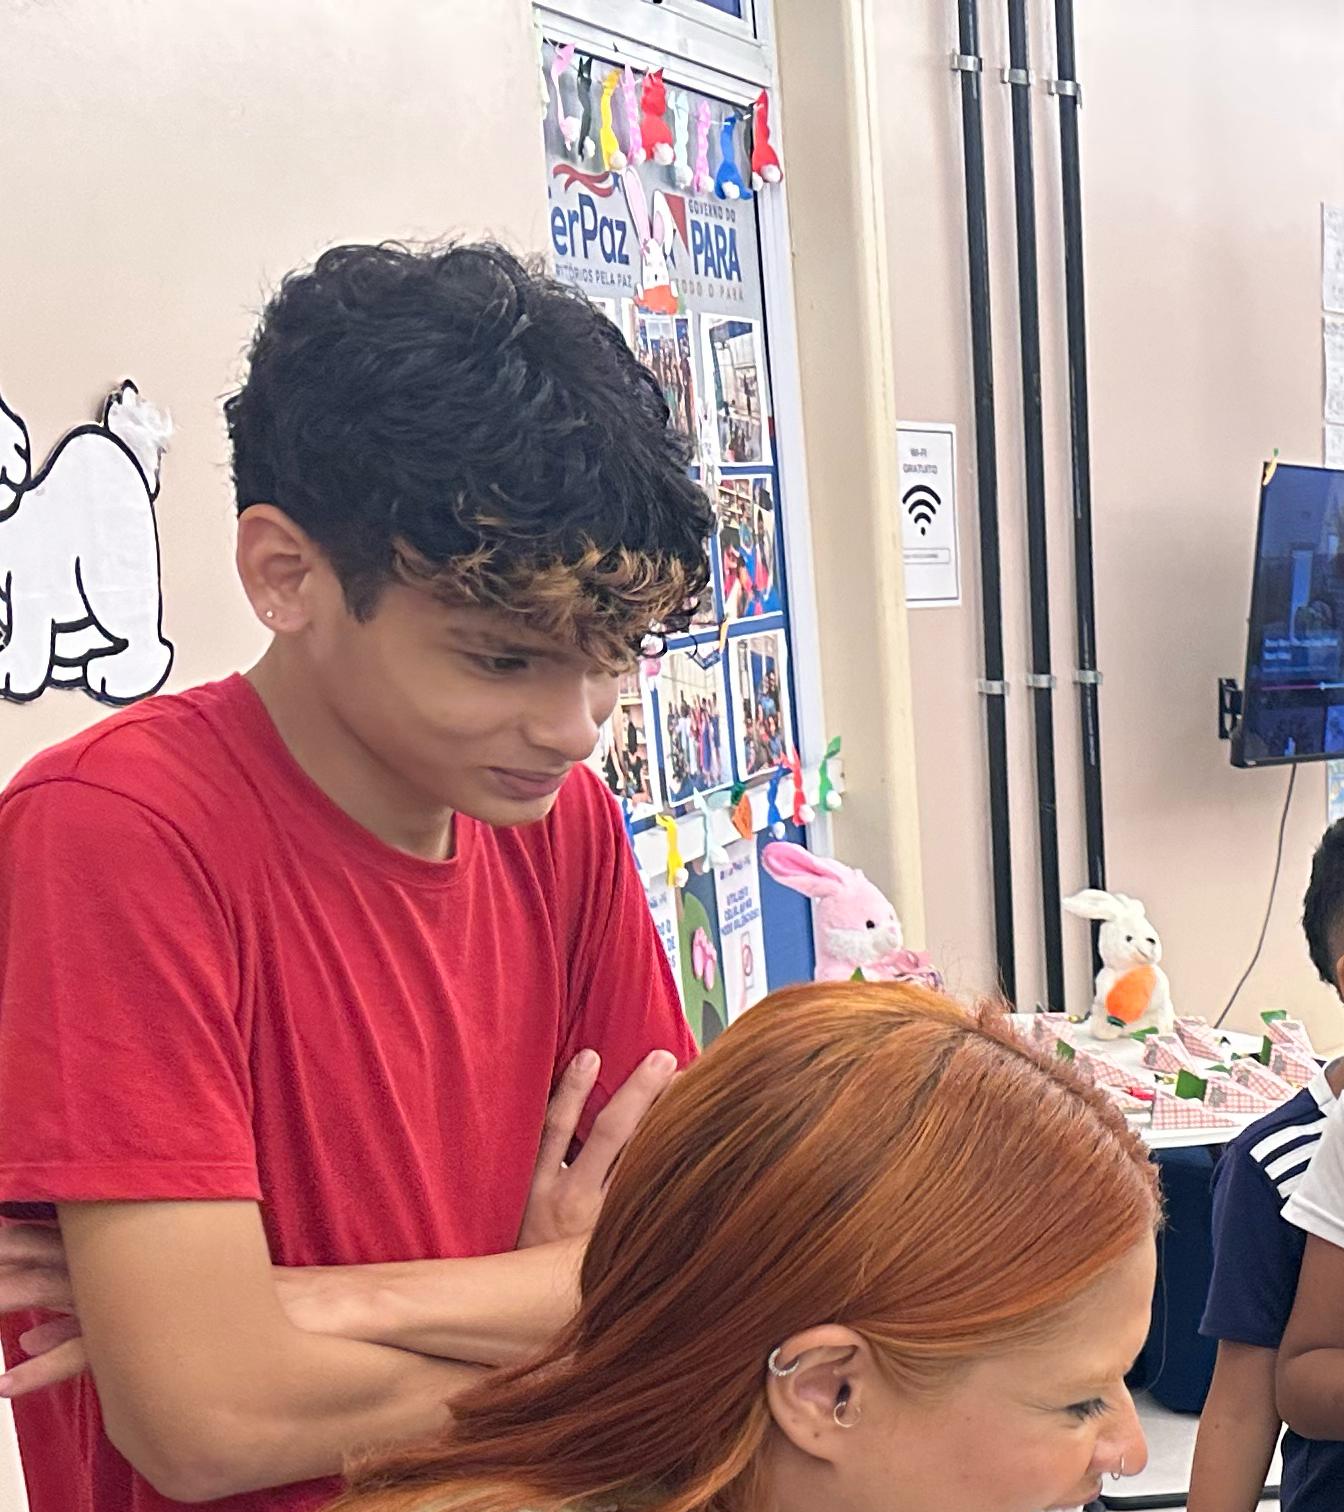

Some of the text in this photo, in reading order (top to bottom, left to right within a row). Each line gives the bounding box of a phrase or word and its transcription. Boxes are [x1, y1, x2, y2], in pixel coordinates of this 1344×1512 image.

[549, 192, 630, 266] erPaz
[726, 207, 736, 223] DO
[618, 273, 632, 289] PAZ
